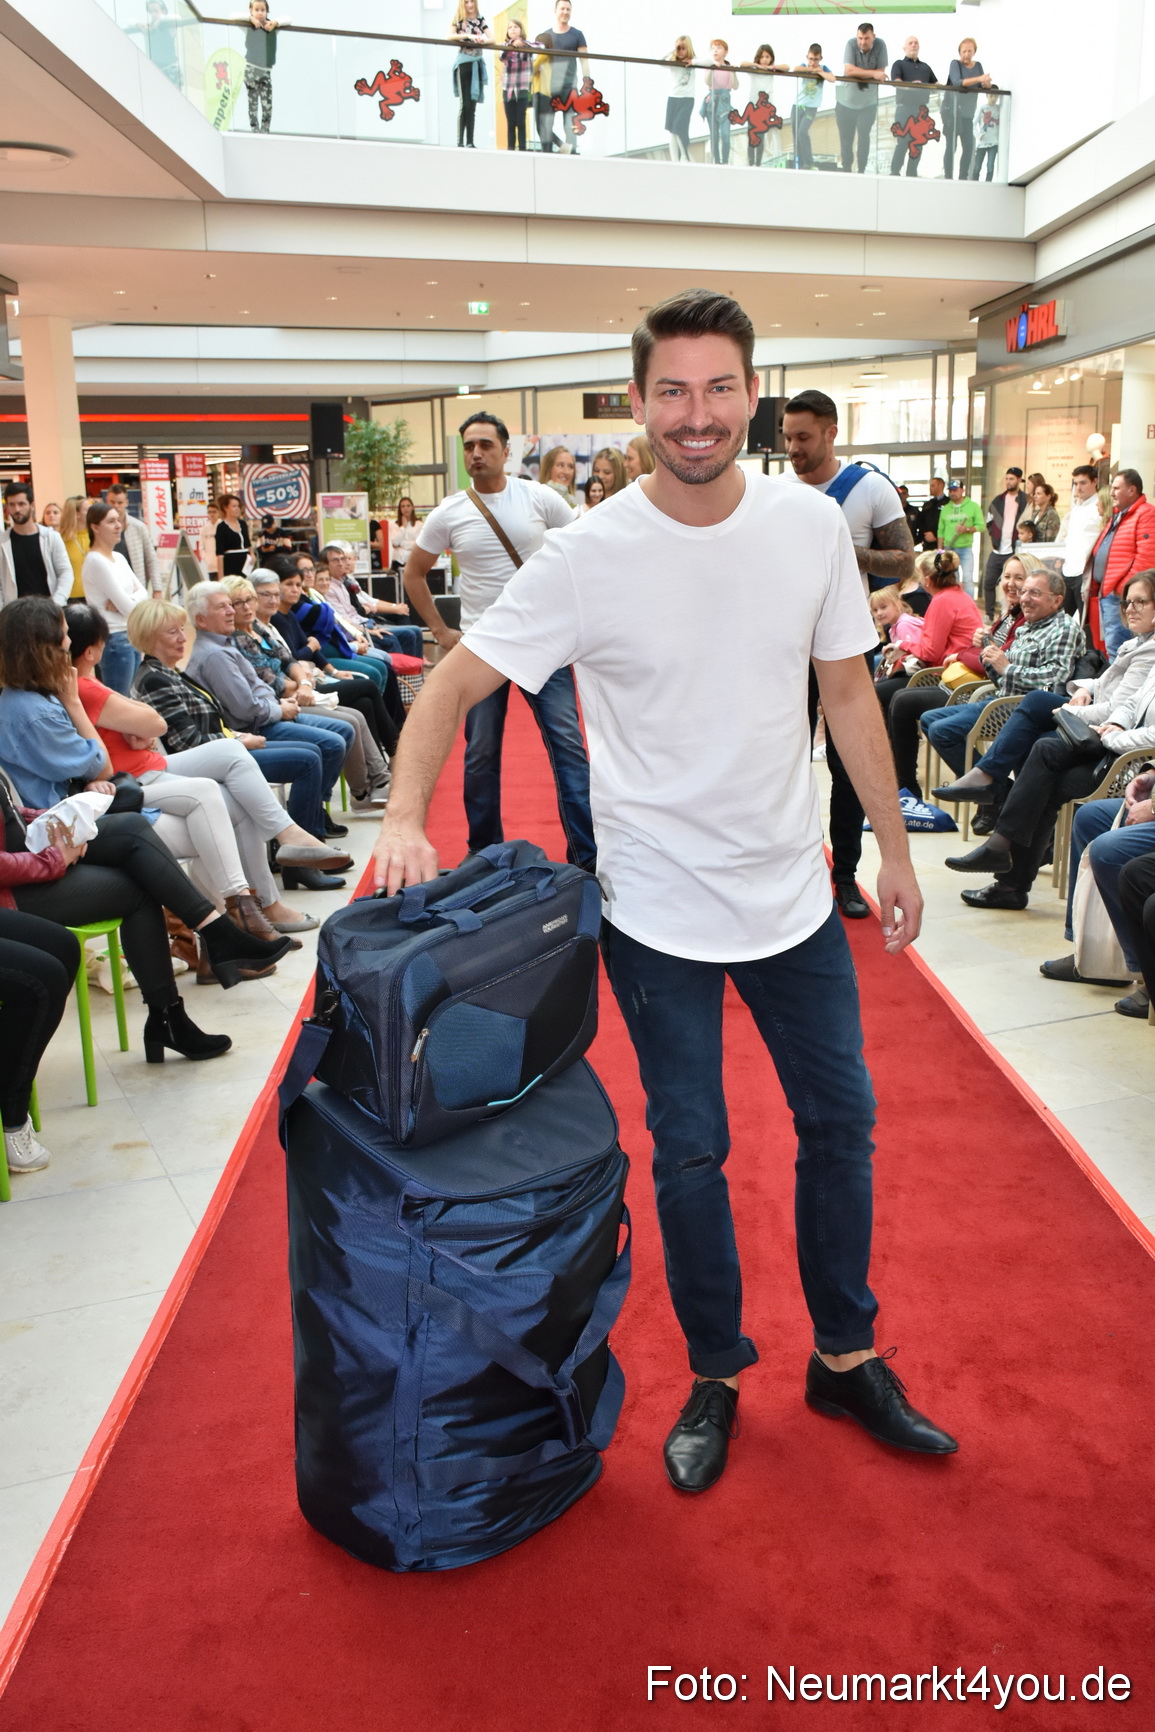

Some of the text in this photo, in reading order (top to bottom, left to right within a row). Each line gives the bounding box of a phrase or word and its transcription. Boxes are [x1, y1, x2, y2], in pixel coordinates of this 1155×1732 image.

[1006, 300, 1058, 353] WÖHRL
[154, 486, 168, 531] Markt
[189, 488, 205, 500] dm
